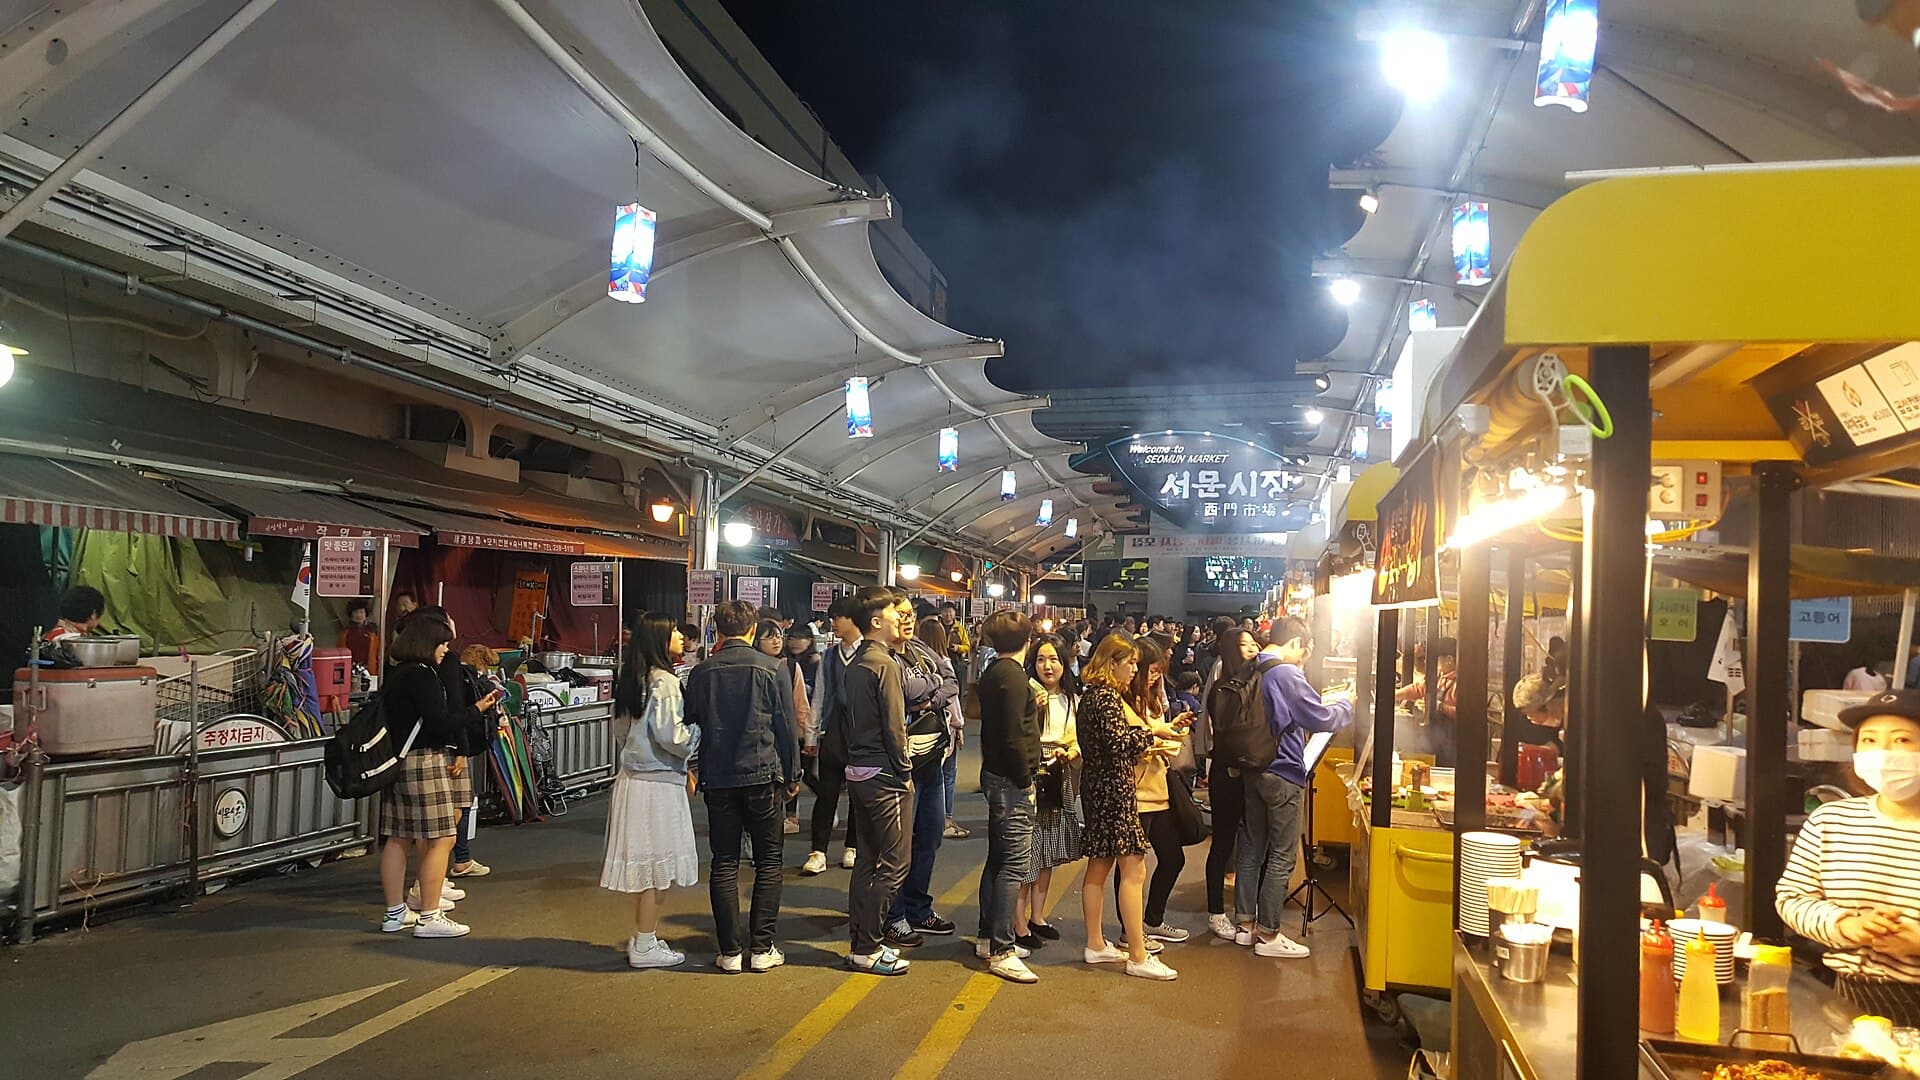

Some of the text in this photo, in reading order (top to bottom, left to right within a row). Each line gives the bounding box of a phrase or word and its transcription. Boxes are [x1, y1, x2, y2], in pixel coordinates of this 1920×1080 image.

[1129, 444, 1185, 454] Welcome to
[1144, 454, 1230, 464] SEOMUN MARKET
[1160, 470, 1292, 500] 서문시장
[1204, 502, 1277, 517] 西門市場
[334, 541, 355, 552] 좋은집
[1799, 611, 1841, 625] 고등어
[204, 726, 265, 747] 주정차금지
